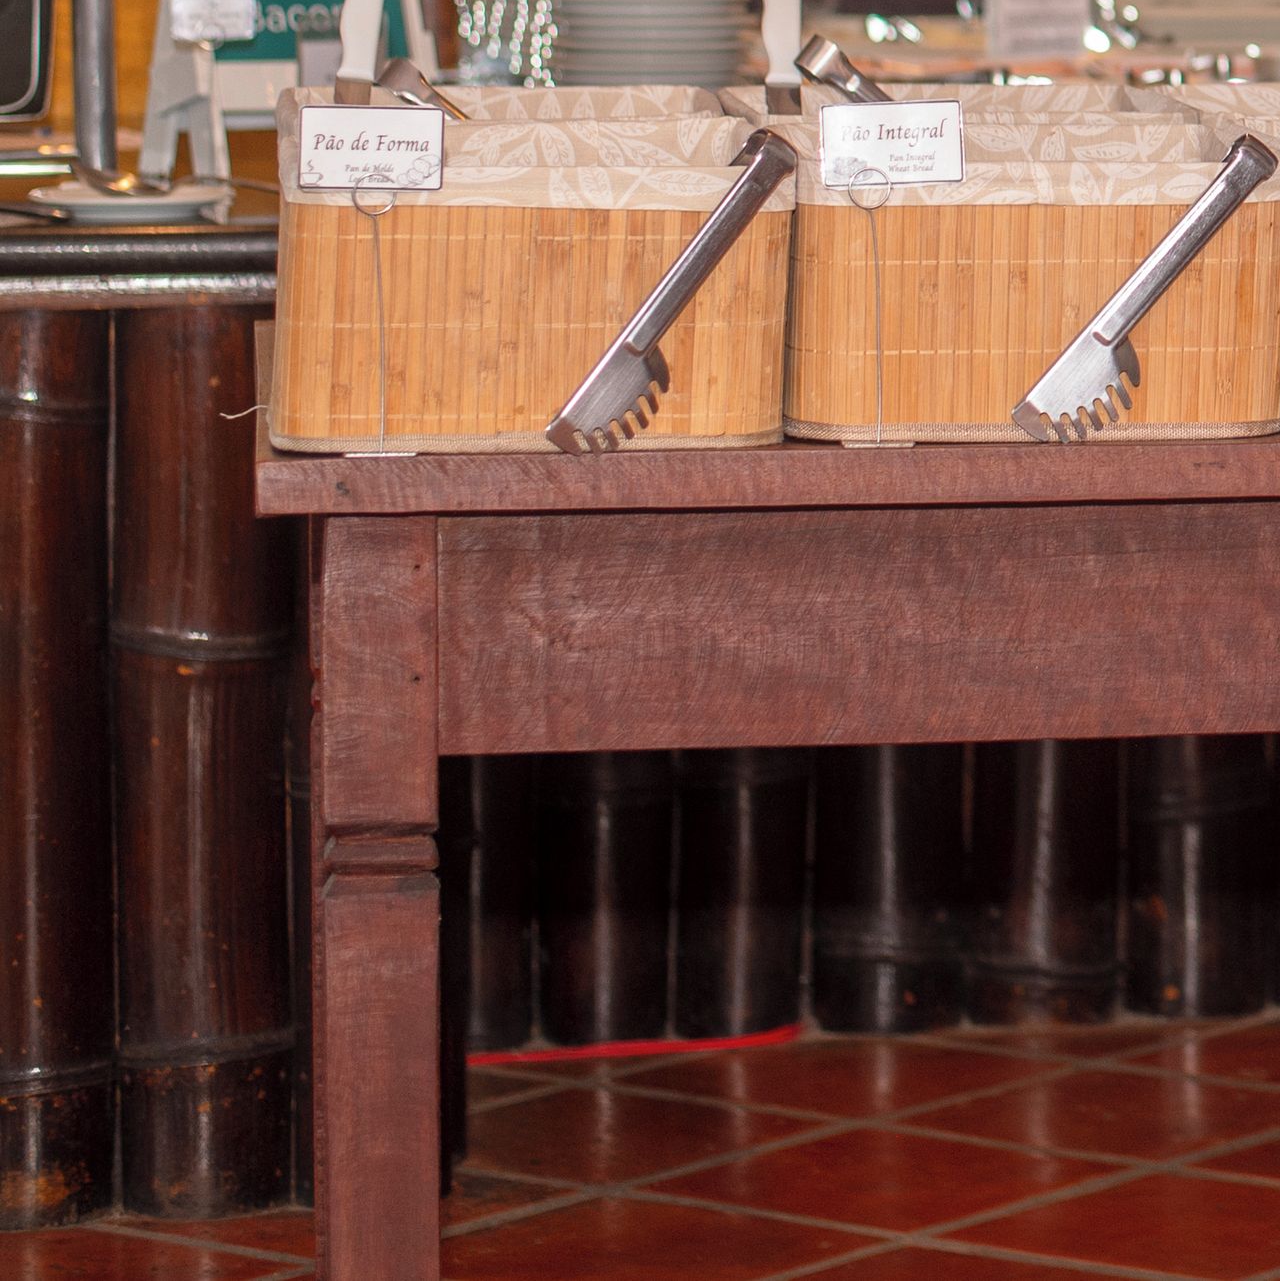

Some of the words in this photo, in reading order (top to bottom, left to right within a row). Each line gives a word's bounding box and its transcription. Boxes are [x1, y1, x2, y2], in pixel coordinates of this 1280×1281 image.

[313, 133, 345, 151] Pão
[350, 130, 370, 151] de
[376, 134, 430, 152] Forma
[842, 125, 870, 141] Pão
[877, 118, 948, 147] Integral
